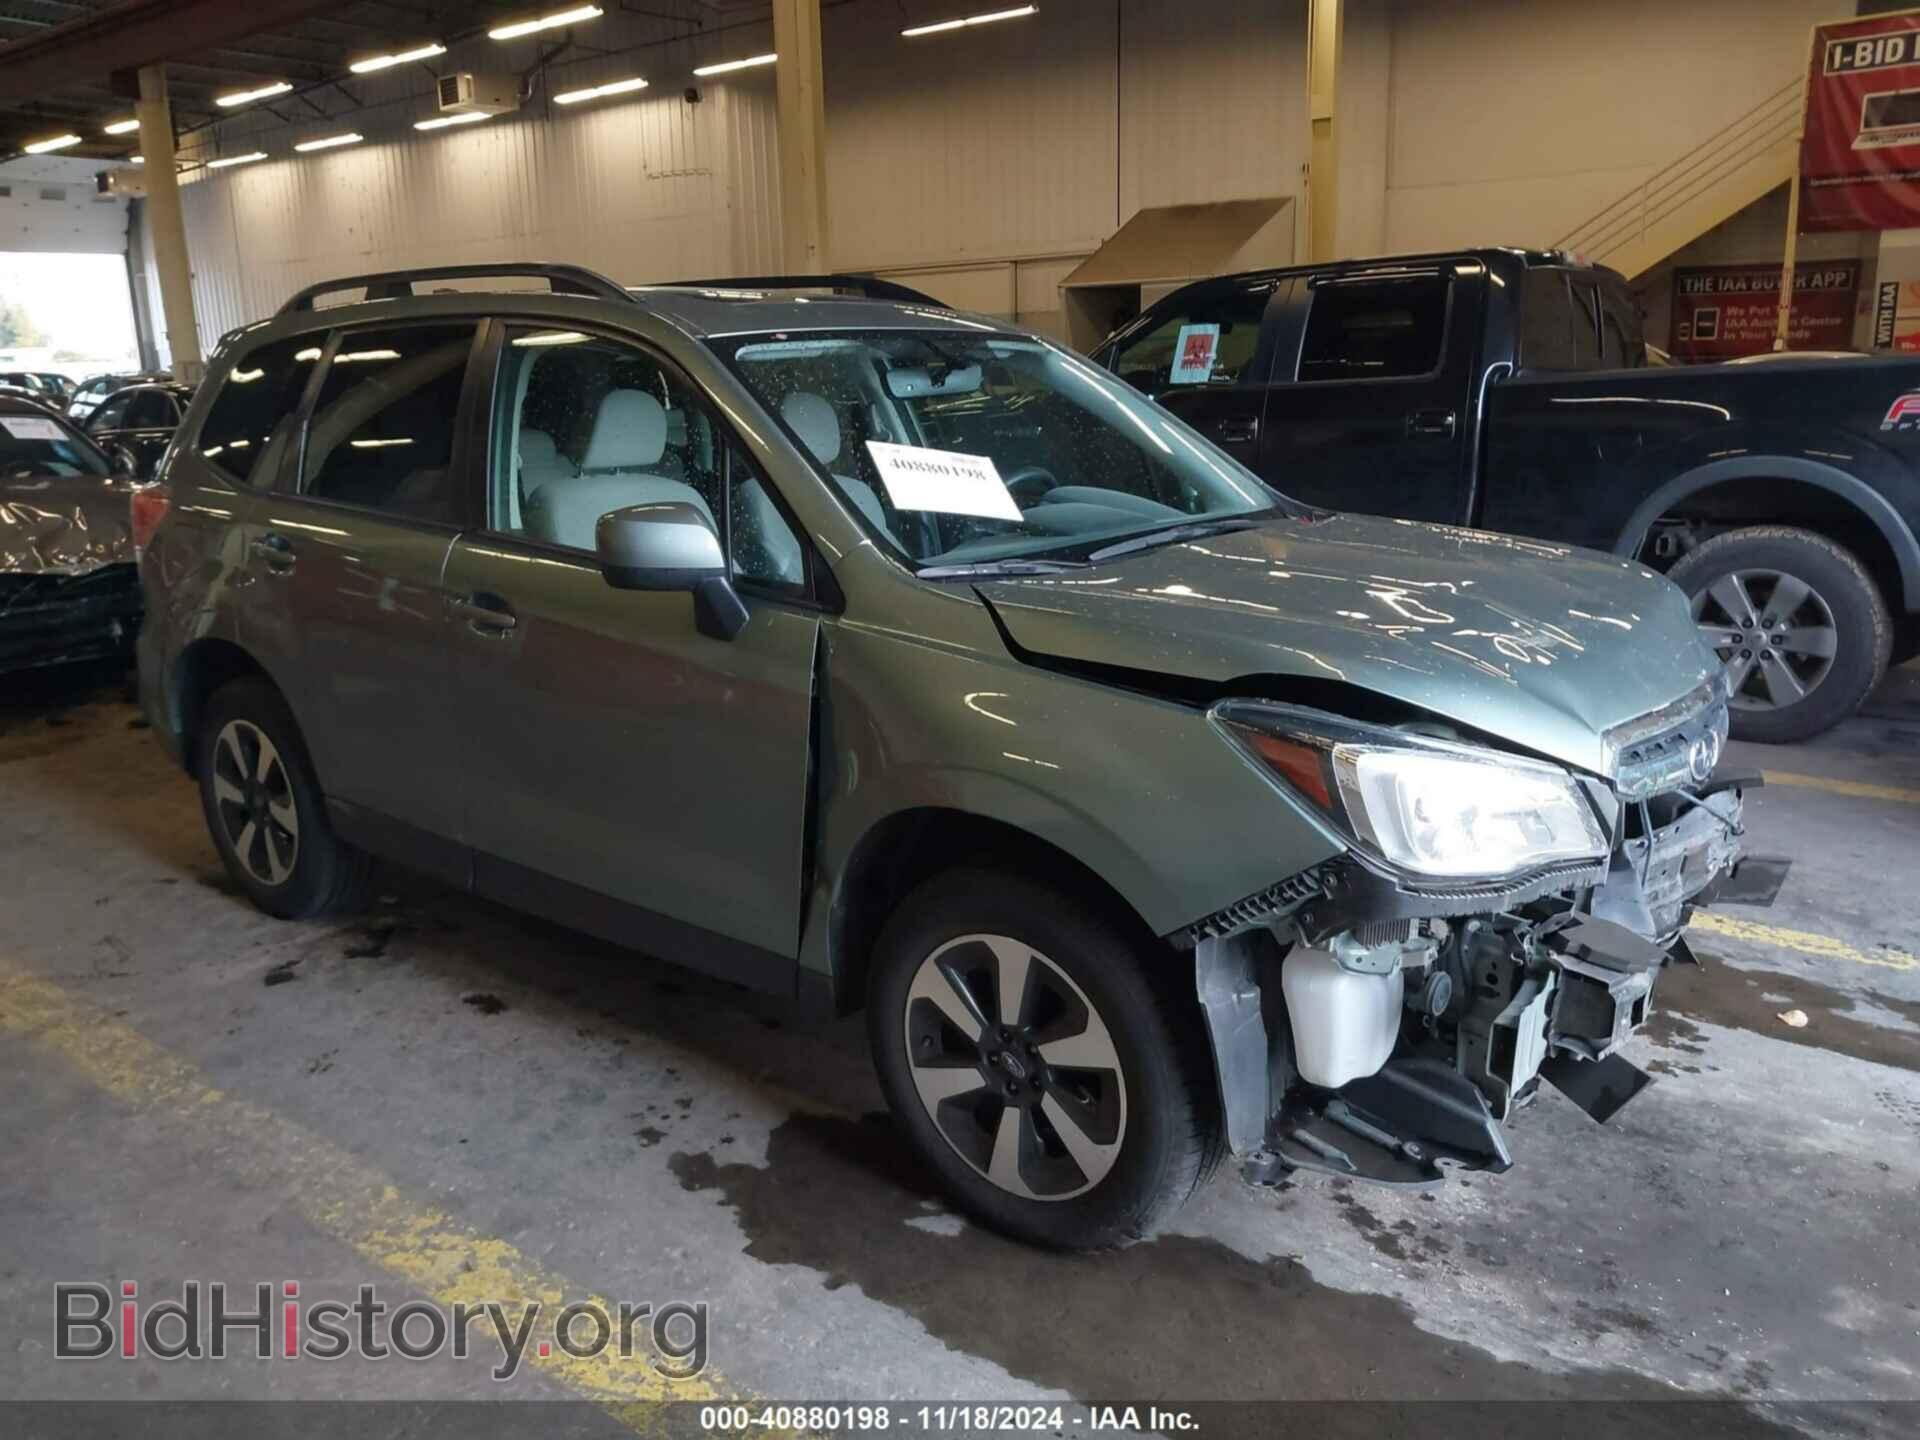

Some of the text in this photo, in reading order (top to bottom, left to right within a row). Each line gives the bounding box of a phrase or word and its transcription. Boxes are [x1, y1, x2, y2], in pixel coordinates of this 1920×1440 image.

[1833, 37, 1904, 69] I-BID
[1686, 271, 1847, 292] THE IAA BUR APP
[1877, 284, 1897, 344] WITH IAA
[889, 458, 987, 480] 40880198
